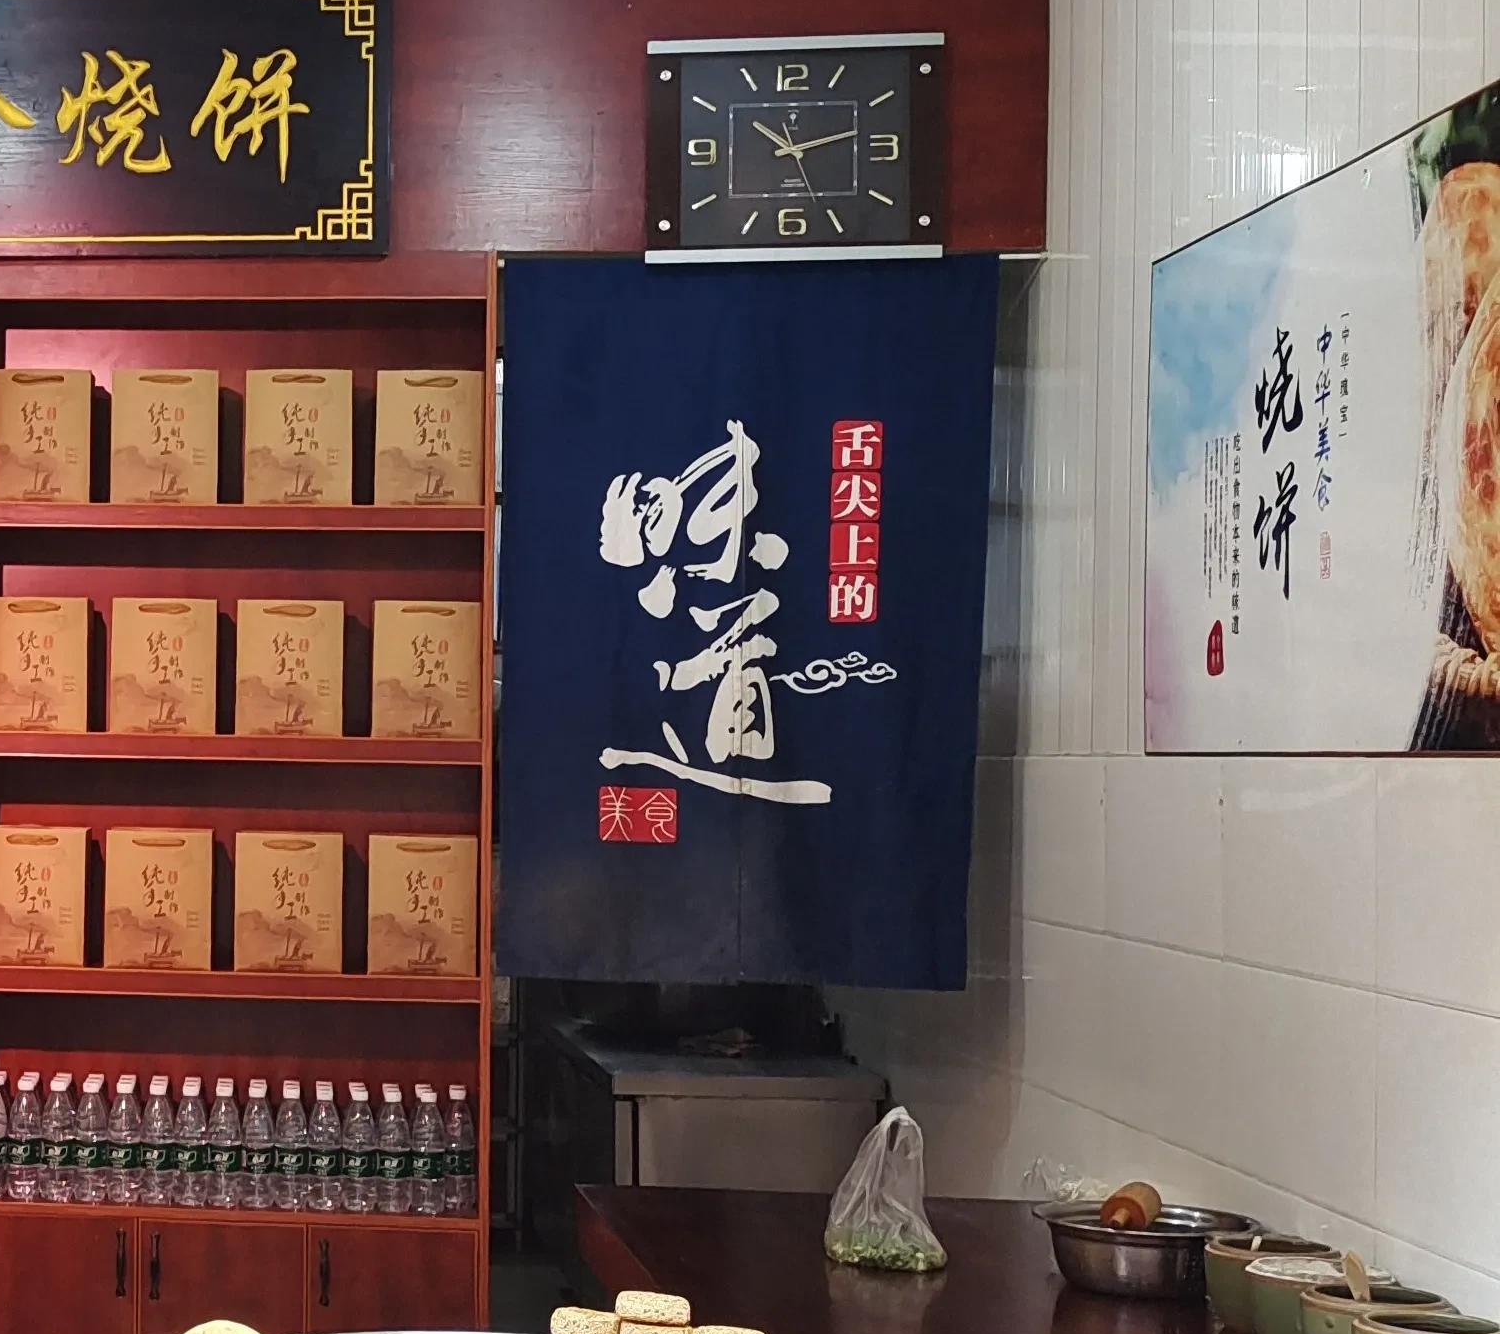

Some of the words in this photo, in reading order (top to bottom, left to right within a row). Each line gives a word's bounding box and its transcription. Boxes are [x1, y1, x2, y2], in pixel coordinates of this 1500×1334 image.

[777, 64, 809, 91] 12
[688, 139, 717, 166] 9
[869, 134, 899, 161] 3
[777, 208, 808, 235] 6
[1312, 322, 1333, 512] 中华美食
[1253, 326, 1304, 602] 烧饼
[830, 423, 882, 620] 舌尖上的
[599, 419, 833, 805] 味道
[600, 787, 678, 842] 美食
